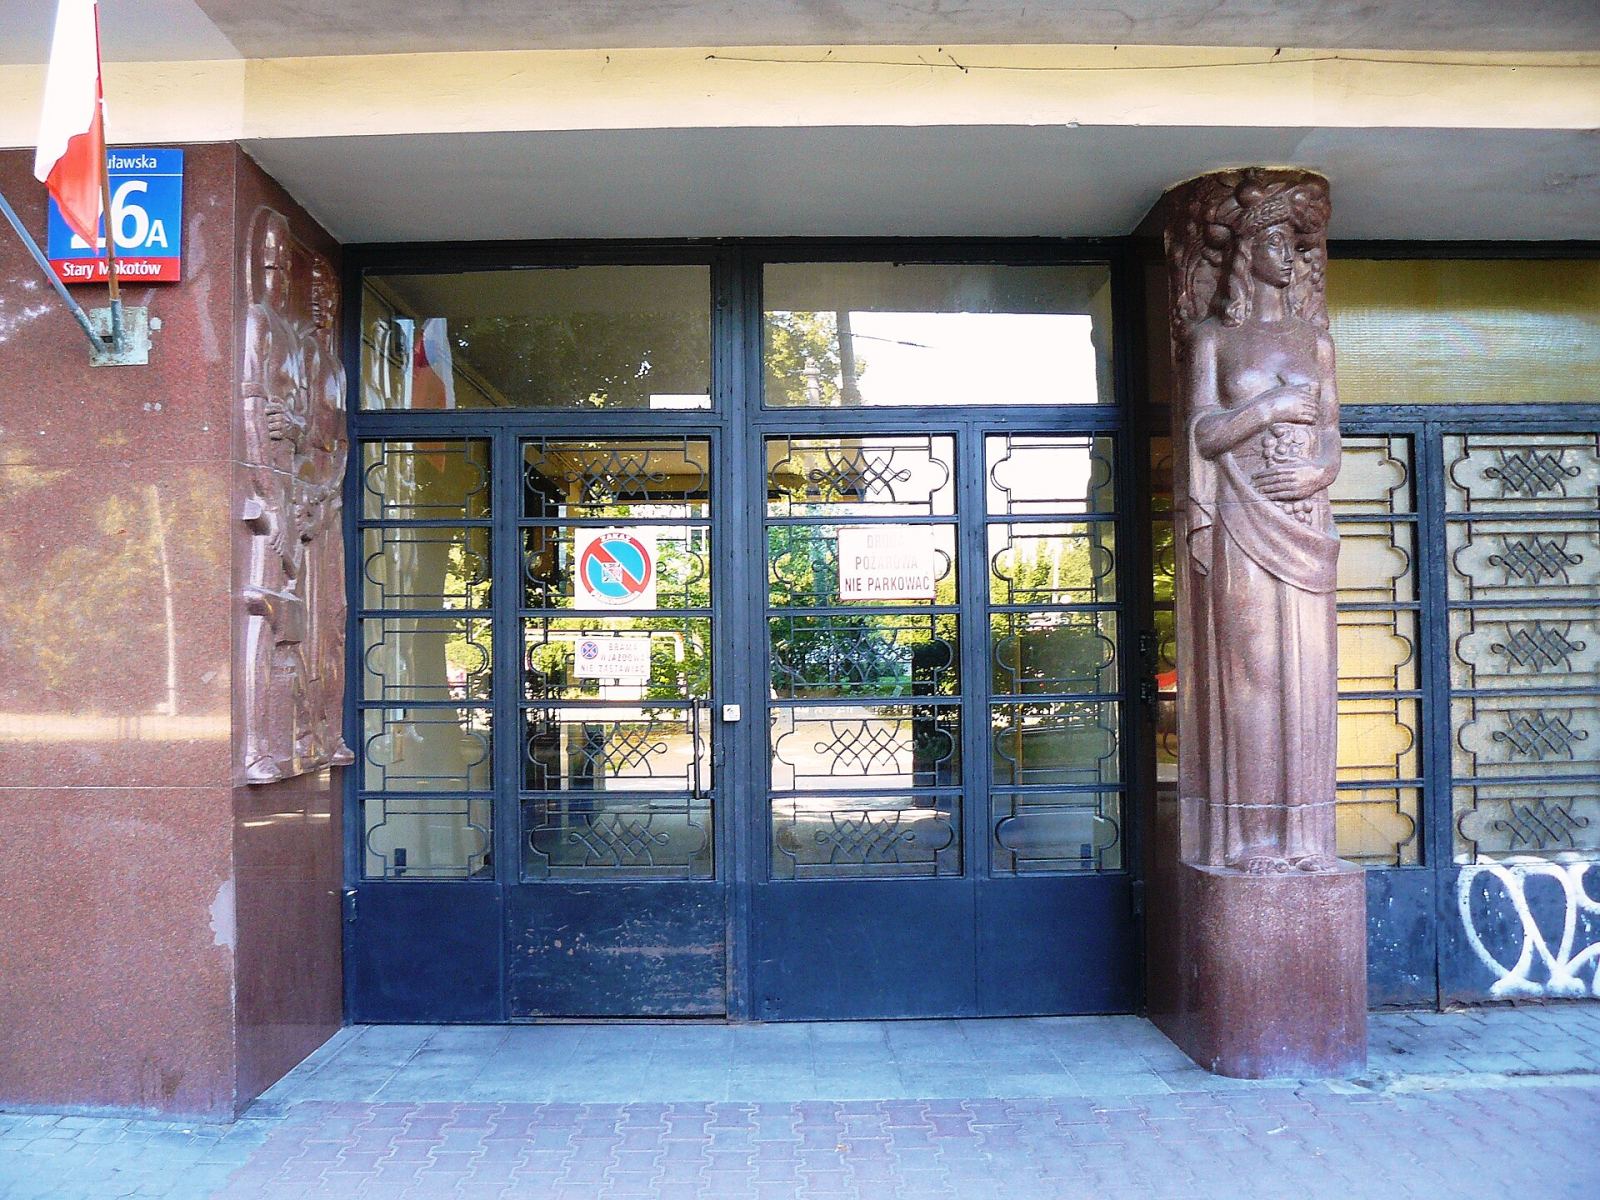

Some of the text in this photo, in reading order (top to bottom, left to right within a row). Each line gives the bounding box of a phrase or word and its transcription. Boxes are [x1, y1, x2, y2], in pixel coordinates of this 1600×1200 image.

[107, 154, 157, 169] uławska
[62, 262, 94, 280] Stary
[845, 577, 862, 592] NIE
[581, 664, 594, 673] NIE
